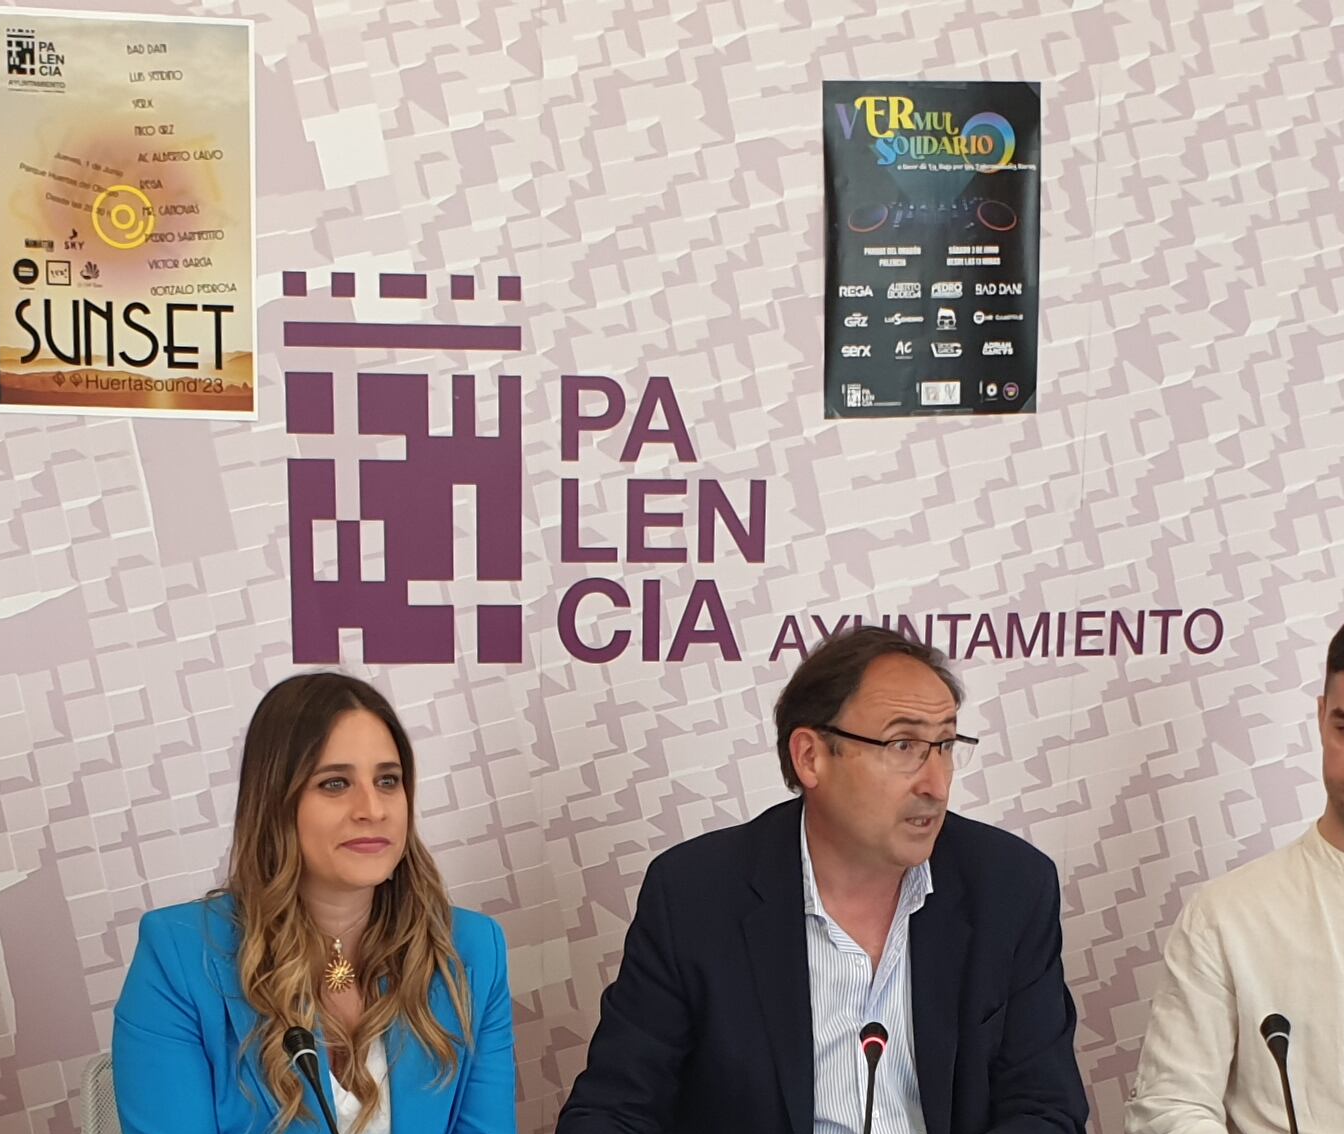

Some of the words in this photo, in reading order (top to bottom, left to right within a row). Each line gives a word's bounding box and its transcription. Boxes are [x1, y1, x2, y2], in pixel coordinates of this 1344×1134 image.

[39, 41, 55, 52] PA
[39, 54, 65, 66] LEN
[39, 65, 63, 77] CIA
[193, 150, 223, 161] CALVO
[874, 134, 994, 166] SOLIDARIO
[838, 285, 874, 298] REGA
[975, 283, 996, 296] BAD
[15, 298, 234, 370] SUNSET
[895, 340, 912, 354] AC
[85, 375, 224, 393] Huertasound'23
[561, 375, 697, 462] PA
[561, 478, 768, 564] LEN
[557, 578, 742, 664] CIA
